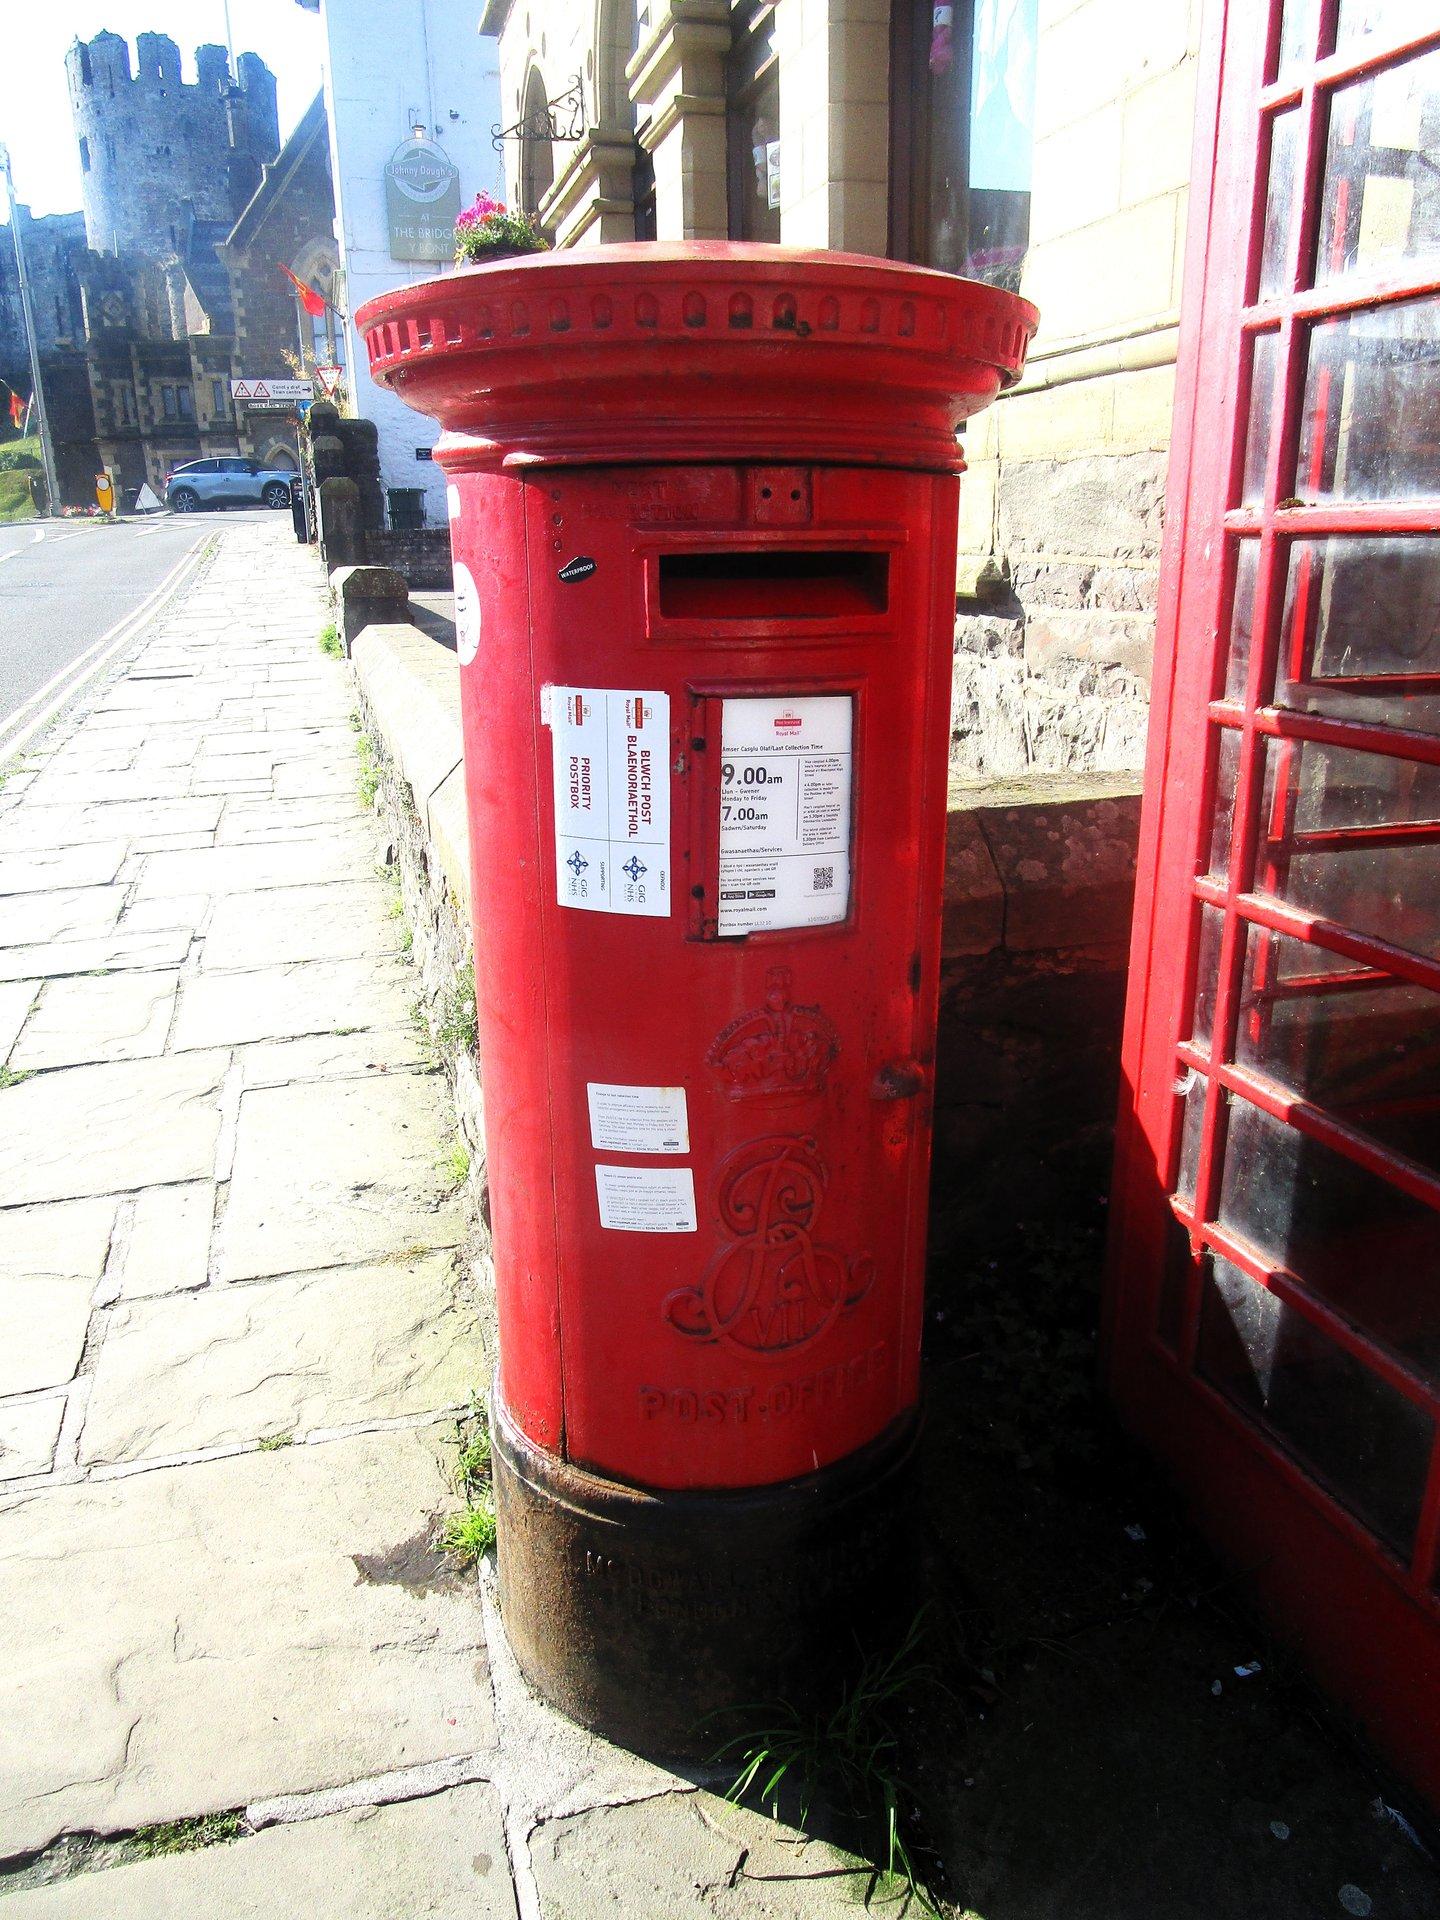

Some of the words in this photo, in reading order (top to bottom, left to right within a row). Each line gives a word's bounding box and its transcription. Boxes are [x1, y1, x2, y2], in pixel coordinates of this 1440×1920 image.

[392, 165, 418, 177] Johnny
[420, 165, 453, 177] Dough's
[393, 227, 415, 239] THE
[418, 228, 453, 239] BRIDG
[419, 242, 449, 254] BONT
[560, 563, 594, 579] WATERPROOF
[640, 749, 652, 791] BLWCH
[722, 763, 783, 785] 9.00am
[569, 756, 580, 810] POSTBOX
[581, 757, 592, 811] PRIORITY
[626, 734, 639, 838] BLAENORIAETHOL
[641, 794, 652, 826] POST
[721, 806, 769, 821] 7.00am
[580, 879, 588, 898] GIG
[637, 884, 646, 904] GIG
[720, 906, 768, 915] www.royalmail.com
